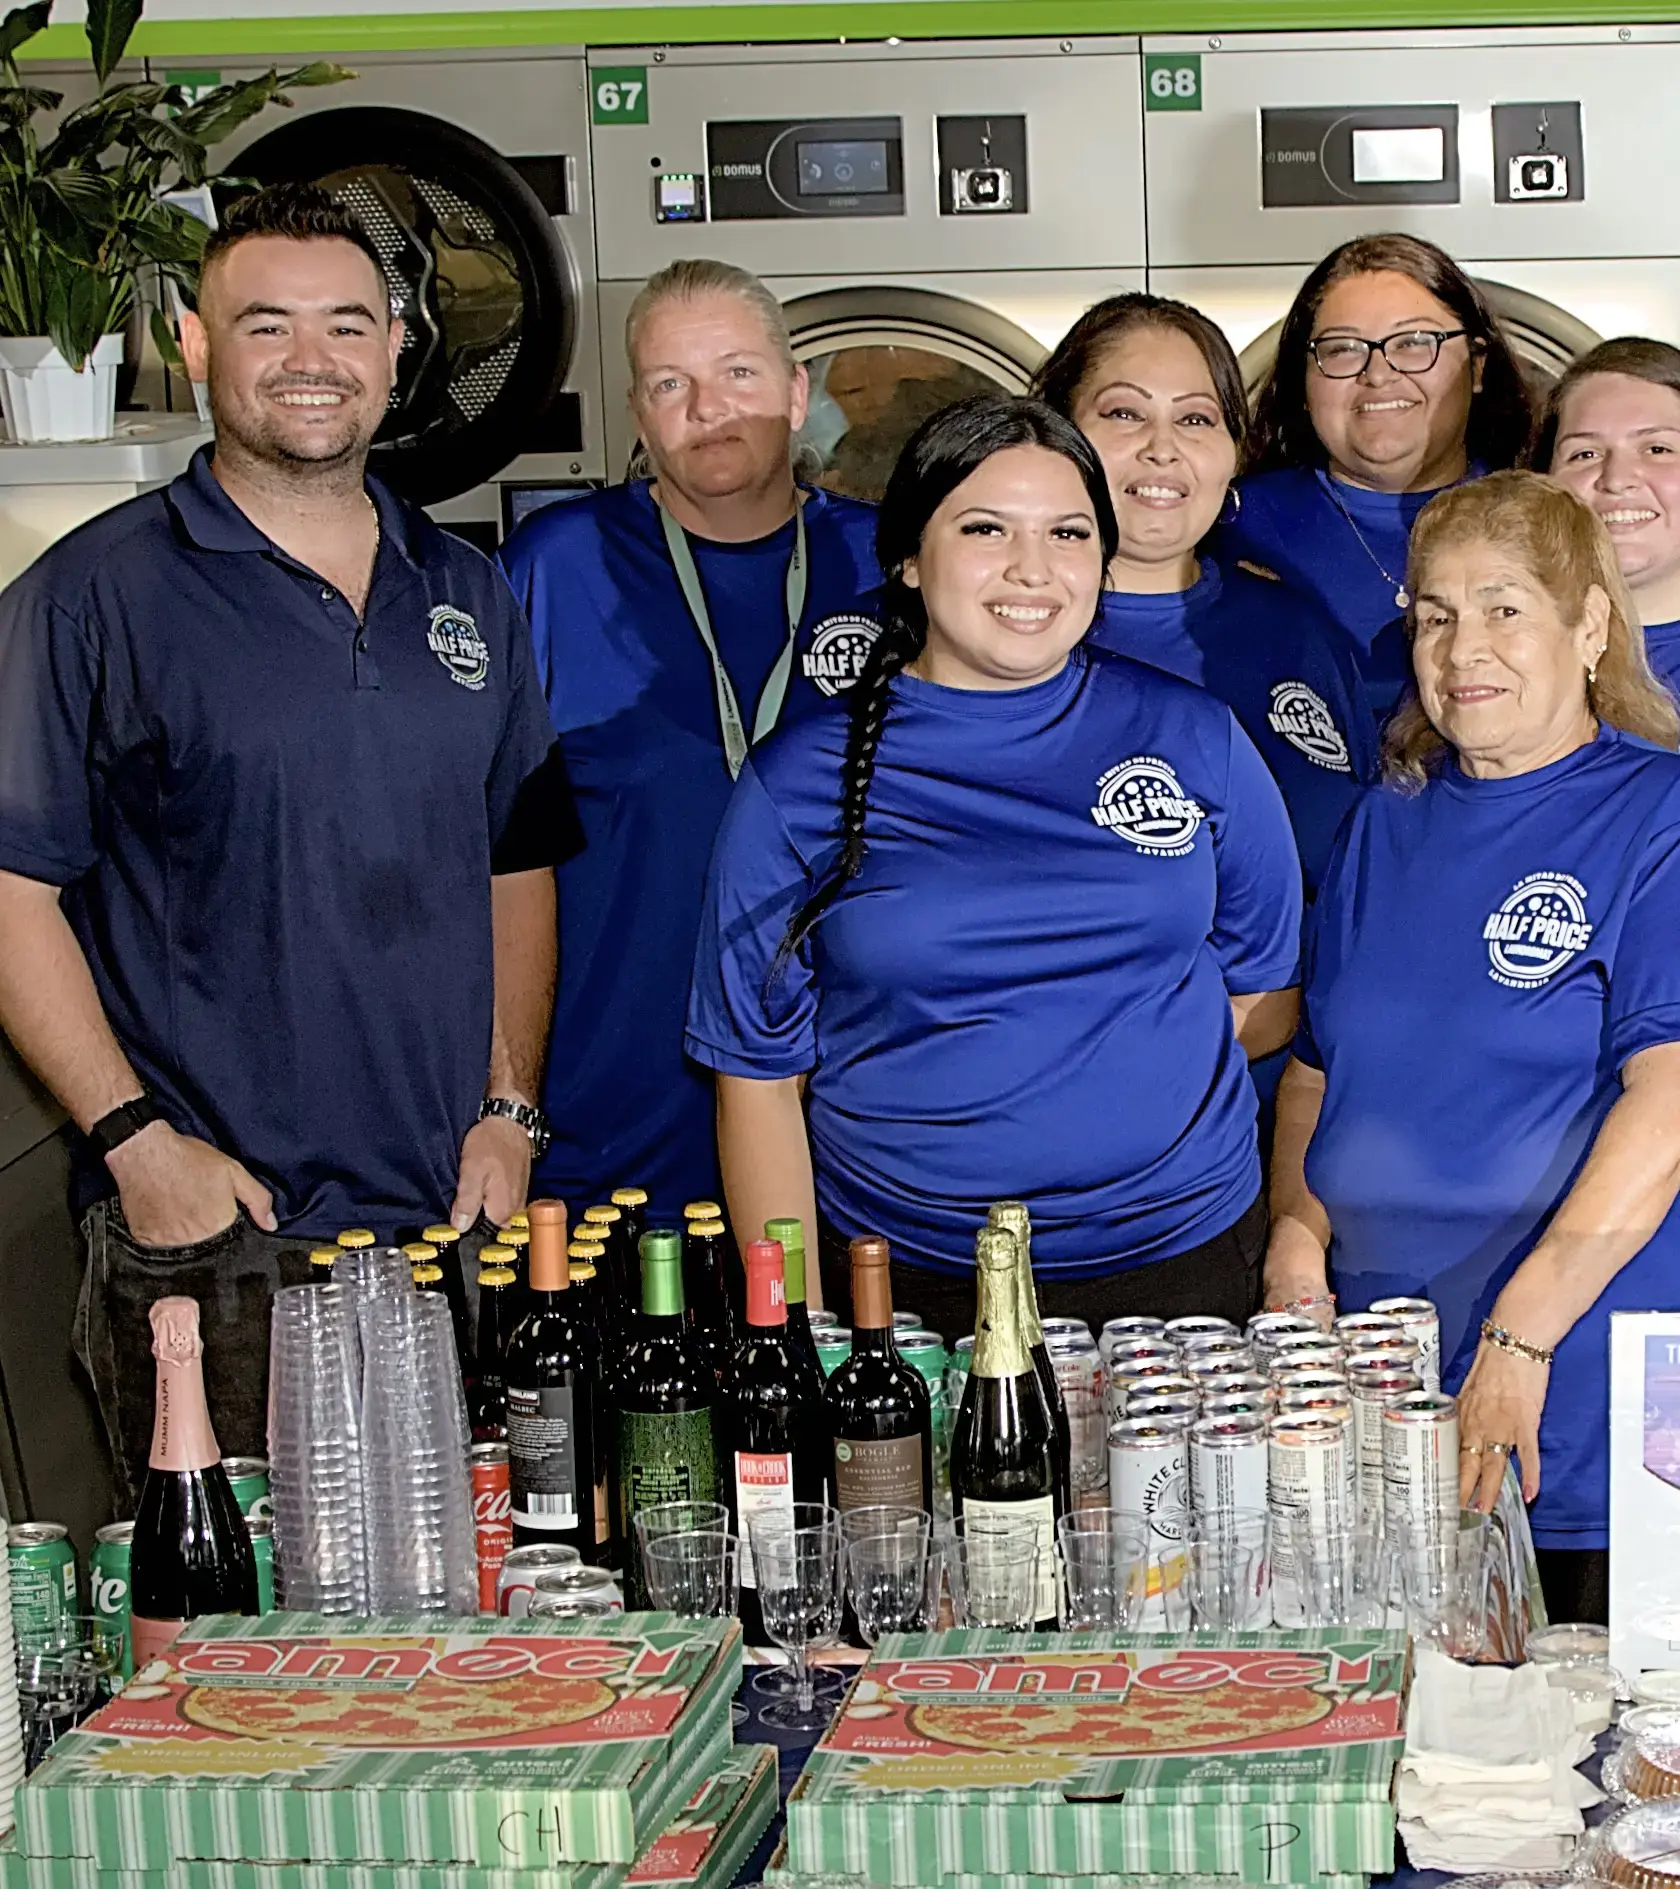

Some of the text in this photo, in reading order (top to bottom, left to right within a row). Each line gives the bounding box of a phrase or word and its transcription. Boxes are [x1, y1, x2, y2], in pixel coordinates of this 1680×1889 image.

[1150, 68, 1197, 98] 68
[596, 82, 643, 111] 67
[723, 163, 763, 176] DOMUS
[427, 632, 457, 654] HALF
[802, 653, 849, 677] HALF
[1267, 712, 1311, 735] HALF
[1091, 798, 1145, 826] HALF
[1143, 796, 1206, 820] PRICE
[1482, 912, 1593, 951] HALF PRICE
[160, 1416, 169, 1456] MUMM
[855, 1446, 901, 1458] BOGLE
[1143, 1456, 1186, 1515] WHITE CL
[484, 1537, 513, 1546] ORIGI
[108, 1722, 191, 1733] FRESH!
[131, 1749, 302, 1759] ORDER ONLINE
[886, 1762, 1050, 1772] ORDER ONLINE
[497, 1805, 563, 1856] CH
[1250, 1822, 1301, 1880] P
